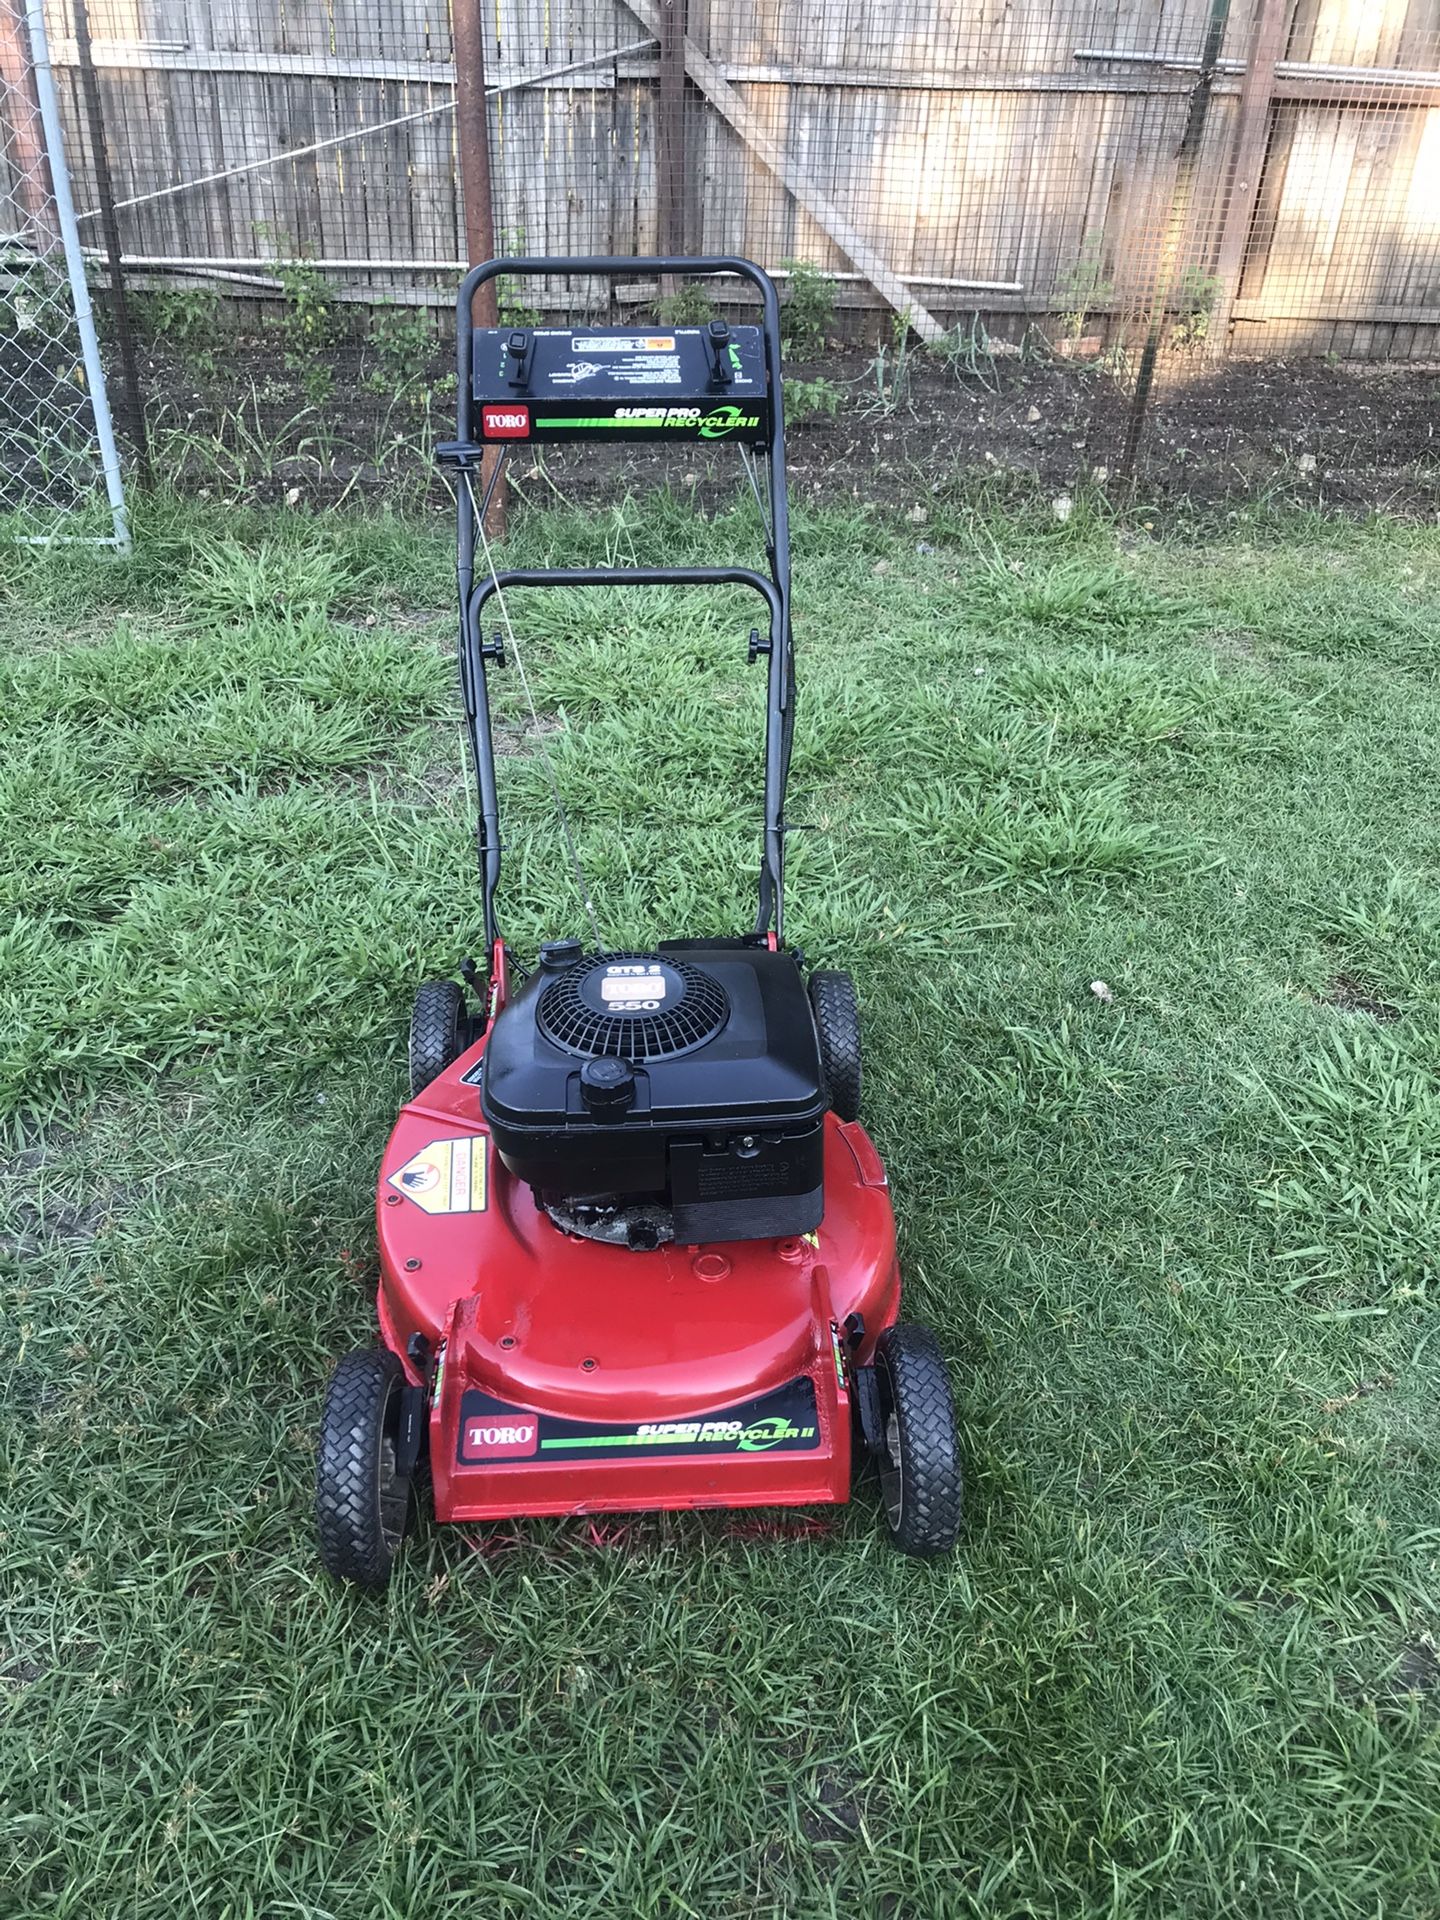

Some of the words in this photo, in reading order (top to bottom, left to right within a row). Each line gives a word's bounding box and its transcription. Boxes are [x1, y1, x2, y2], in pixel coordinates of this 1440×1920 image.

[485, 413, 527, 428] TORO
[613, 407, 668, 419] SUPER
[666, 407, 701, 418] PRO
[663, 416, 748, 428] RECYCLER
[607, 1000, 661, 1011] 550
[455, 1151, 468, 1196] DANGER
[469, 1425, 534, 1446] TORO
[635, 1422, 702, 1436] SUPER
[700, 1420, 743, 1433] PRO
[697, 1427, 797, 1442] RECYCLER
